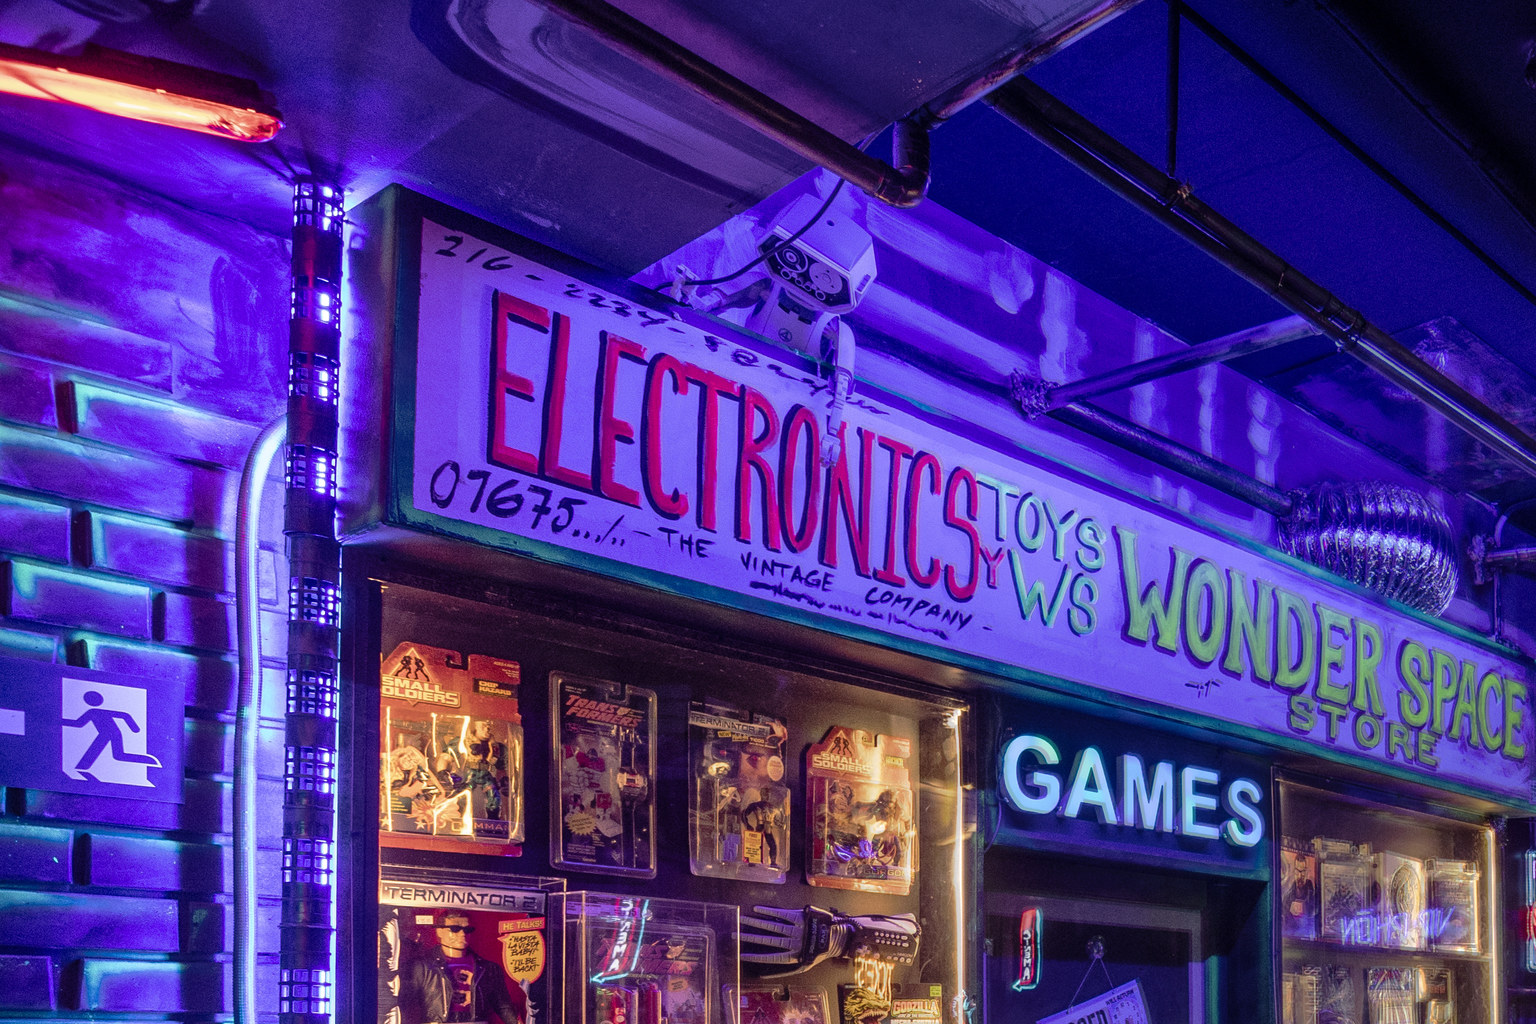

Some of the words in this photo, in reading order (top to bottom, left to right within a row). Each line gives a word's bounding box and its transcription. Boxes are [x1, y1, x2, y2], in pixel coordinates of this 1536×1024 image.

[485, 288, 981, 603] ELECTRONICS
[976, 475, 1107, 573] TOYS
[664, 526, 710, 560] THE
[740, 550, 834, 593] VINTAGE
[864, 586, 973, 633] COMPANY
[1112, 523, 1386, 718] WONDER
[1397, 638, 1528, 761] SPACE
[380, 685, 460, 706] OLDIERS
[381, 676, 442, 693] SMALL
[566, 694, 616, 714] TRANS
[566, 706, 643, 729] FORMERS
[690, 714, 757, 733] TERMINATOR
[1287, 694, 1441, 767] STORE
[812, 755, 872, 774] SOLDIERS
[820, 752, 861, 767] SMALL
[1002, 733, 1266, 847] GAMES
[385, 886, 519, 908] TERMINATOR
[522, 895, 539, 911] 2
[503, 922, 514, 931] HE
[893, 1000, 940, 1016] GODZILLA
